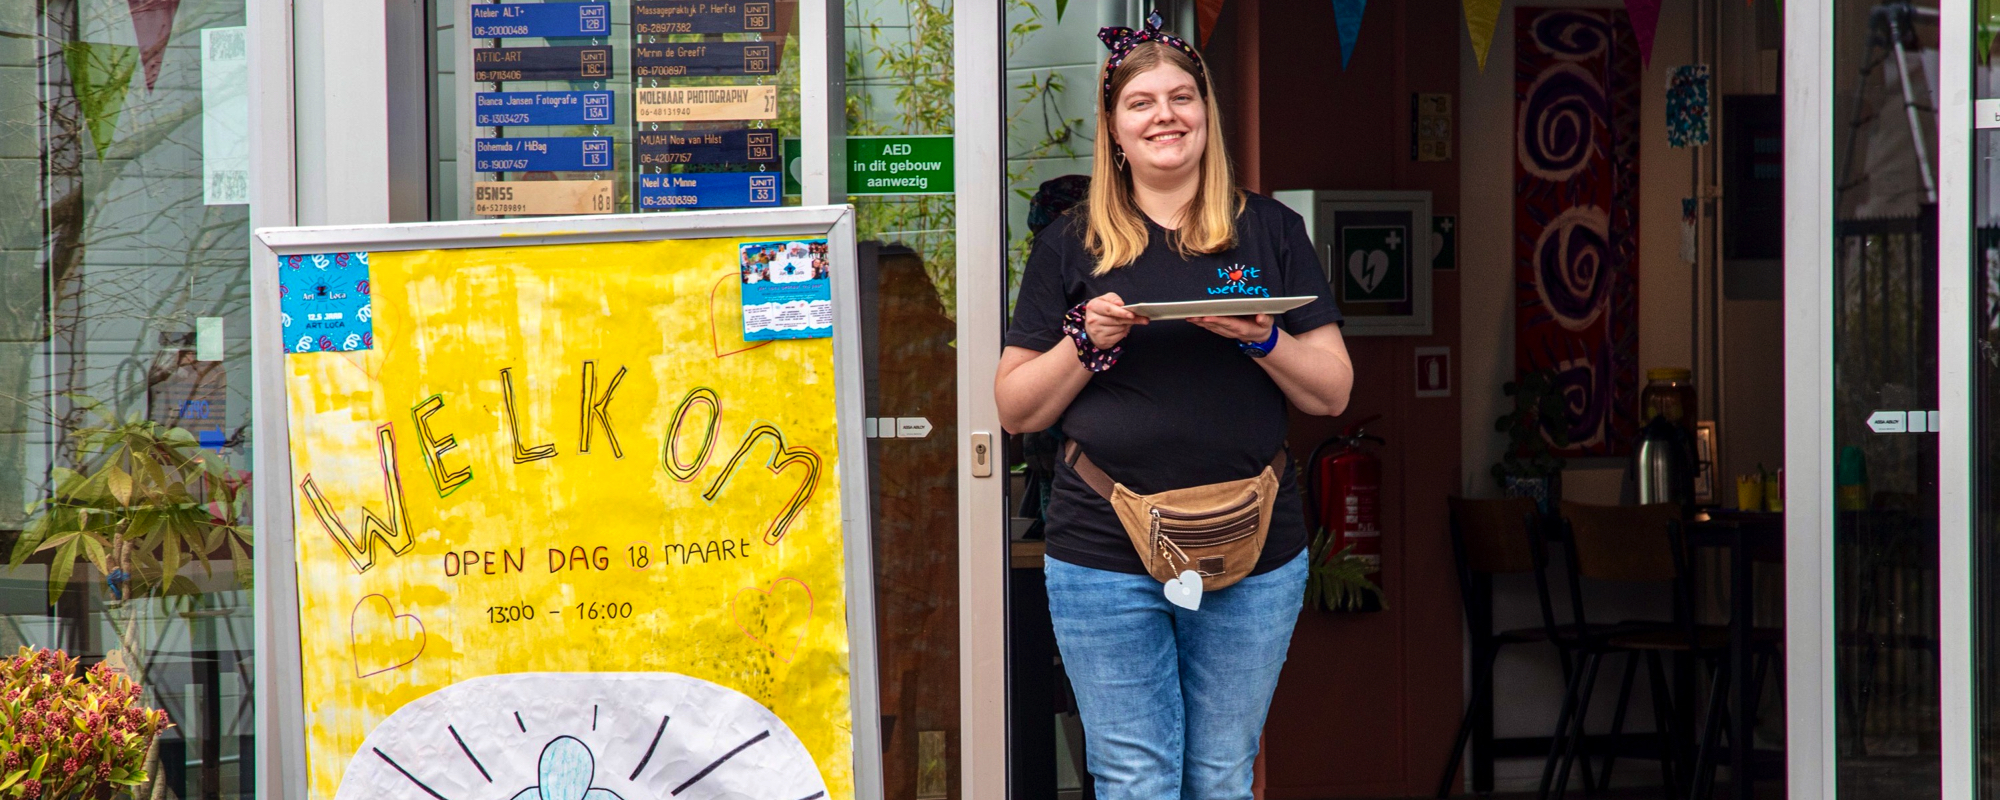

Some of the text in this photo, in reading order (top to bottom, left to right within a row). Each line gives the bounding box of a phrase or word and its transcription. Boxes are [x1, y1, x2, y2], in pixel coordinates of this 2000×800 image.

[474, 8, 499, 18] Atelier
[636, 3, 736, 17] Massagepraktijk P. Herfst
[586, 20, 600, 29] 12B
[750, 17, 763, 26] 19B
[474, 26, 528, 36] 06-20000488
[636, 23, 691, 33] 06-28977382
[665, 47, 674, 57] de
[677, 46, 706, 57] Greeff
[476, 52, 522, 62] ATTIC-ART
[583, 53, 603, 61] UNIT
[587, 64, 601, 74] 18C
[637, 66, 687, 76] 06-17008971
[478, 94, 577, 108] Bianca Jansen Fotografie
[640, 89, 749, 105] MOLENAAR PHOTOGRAPHY
[590, 108, 603, 118] 13A
[640, 108, 691, 116] 06-48131940
[478, 114, 529, 123] 06-13034275
[640, 134, 722, 145] MUAH Noa van Hilst
[584, 143, 605, 151] UNIT
[753, 147, 767, 157] 19A
[882, 144, 912, 156] AED
[591, 154, 600, 163] 13
[640, 153, 692, 163] 06-42077157
[478, 160, 528, 169] 06-19007457
[854, 160, 941, 174] in dit gebouw
[642, 177, 697, 187] Neel & Minne
[867, 175, 928, 189] aanwezig
[476, 187, 513, 201] BSNSS
[757, 190, 769, 199] 33
[476, 204, 526, 212] 06-52789891
[1207, 282, 1270, 298] werkers
[324, 321, 345, 329] LOCA
[300, 359, 822, 574] WELKOM
[444, 538, 749, 577] OPEN DAG 18 MAART
[576, 601, 633, 620] 16:00
